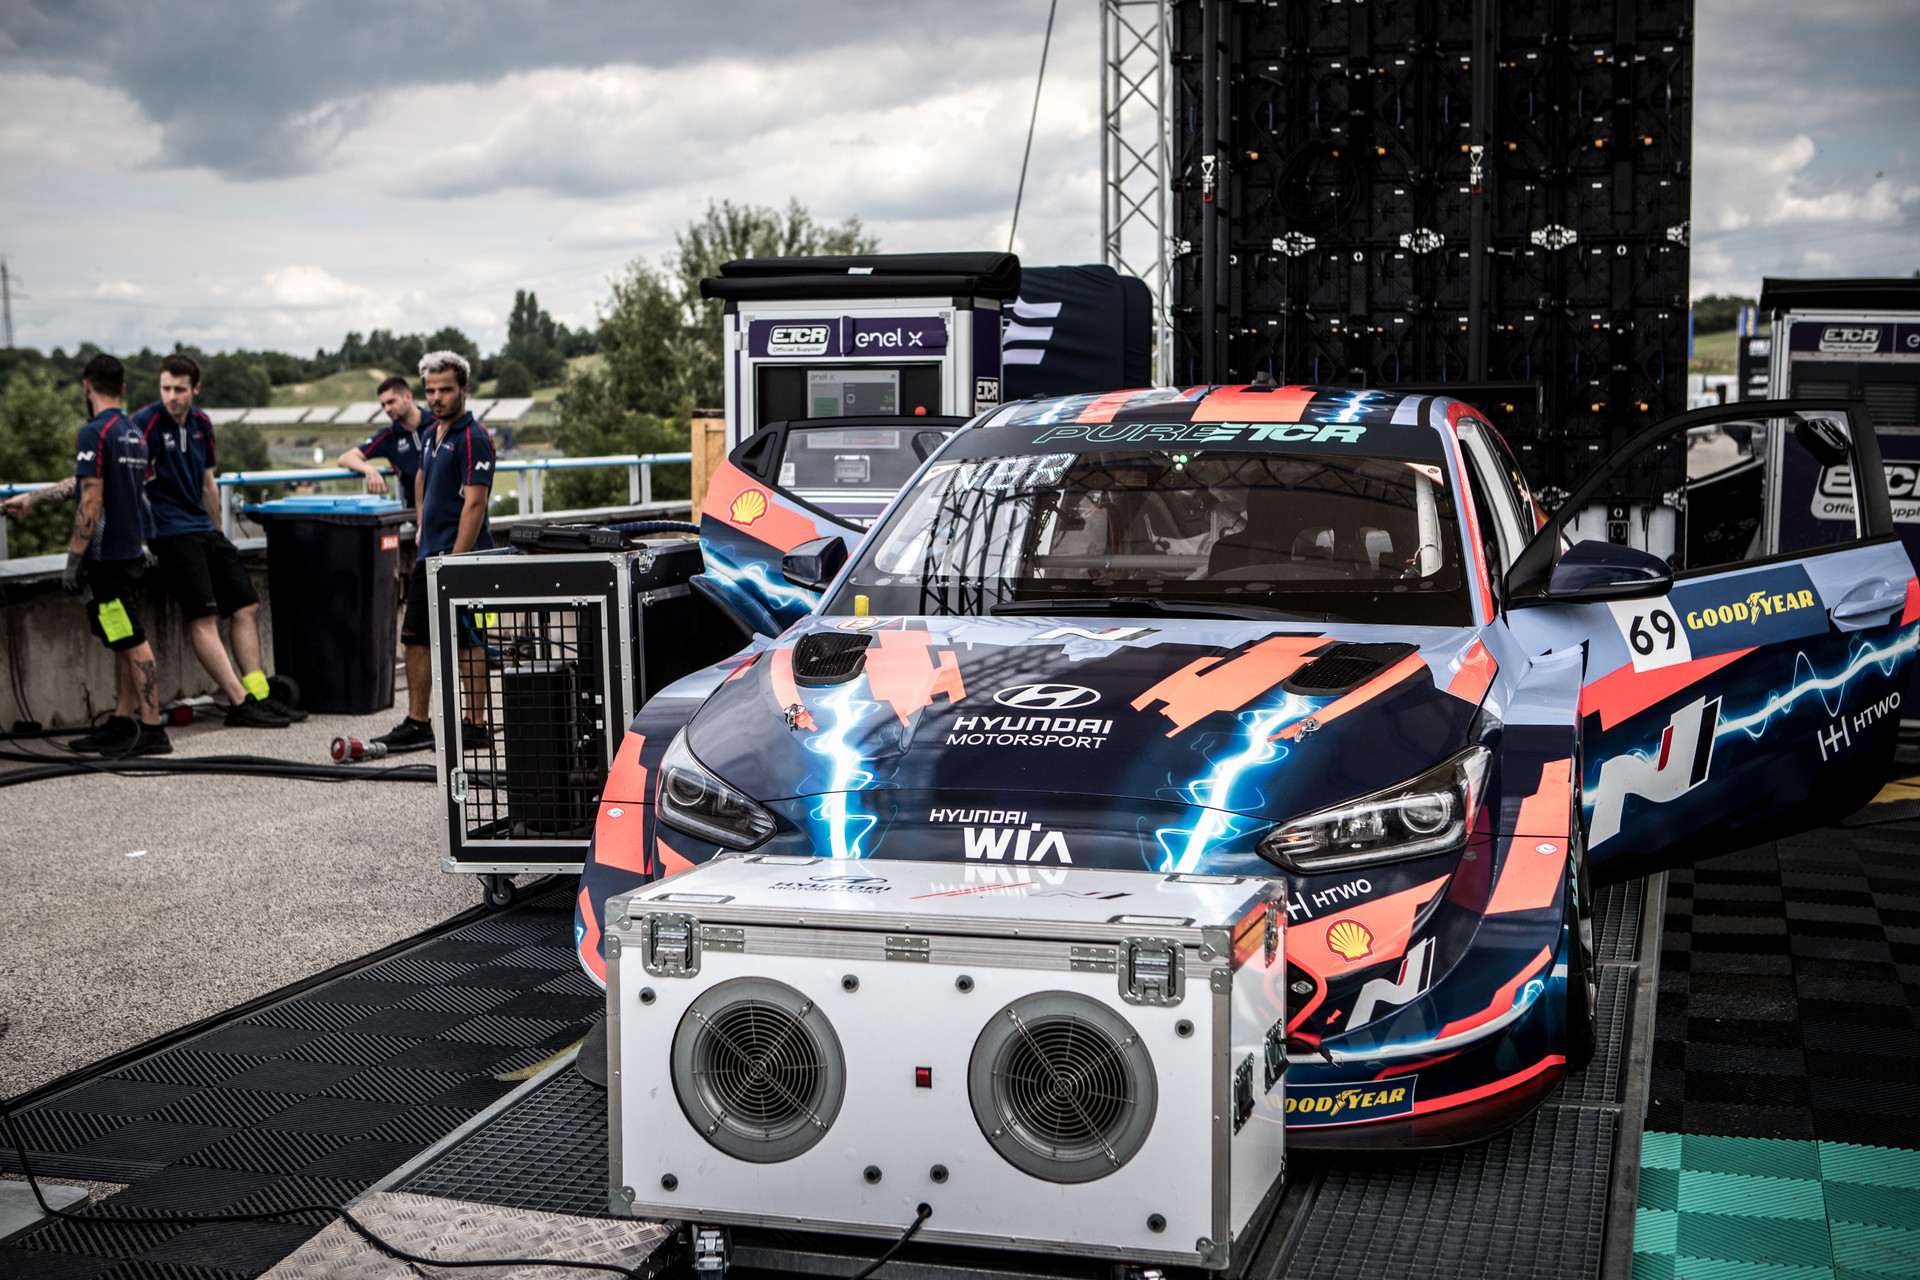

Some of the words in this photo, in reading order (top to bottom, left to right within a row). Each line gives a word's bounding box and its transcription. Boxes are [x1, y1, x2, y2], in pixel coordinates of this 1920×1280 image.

[772, 327, 827, 343] ETCR
[855, 328, 902, 348] enel
[908, 331, 923, 347] x
[1823, 328, 1879, 342] ETCR
[977, 380, 999, 401] ETCR
[1686, 589, 1815, 631] GOODYEAR
[1629, 609, 1676, 656] 69
[1853, 692, 1901, 733] HTWO
[952, 716, 1114, 734] HYUNDAI
[945, 733, 1107, 749] MOTORSPORT
[929, 808, 1028, 824] HYUNDAI
[1312, 878, 1372, 908] HTWO
[1285, 1087, 1406, 1115] OODYEAR
